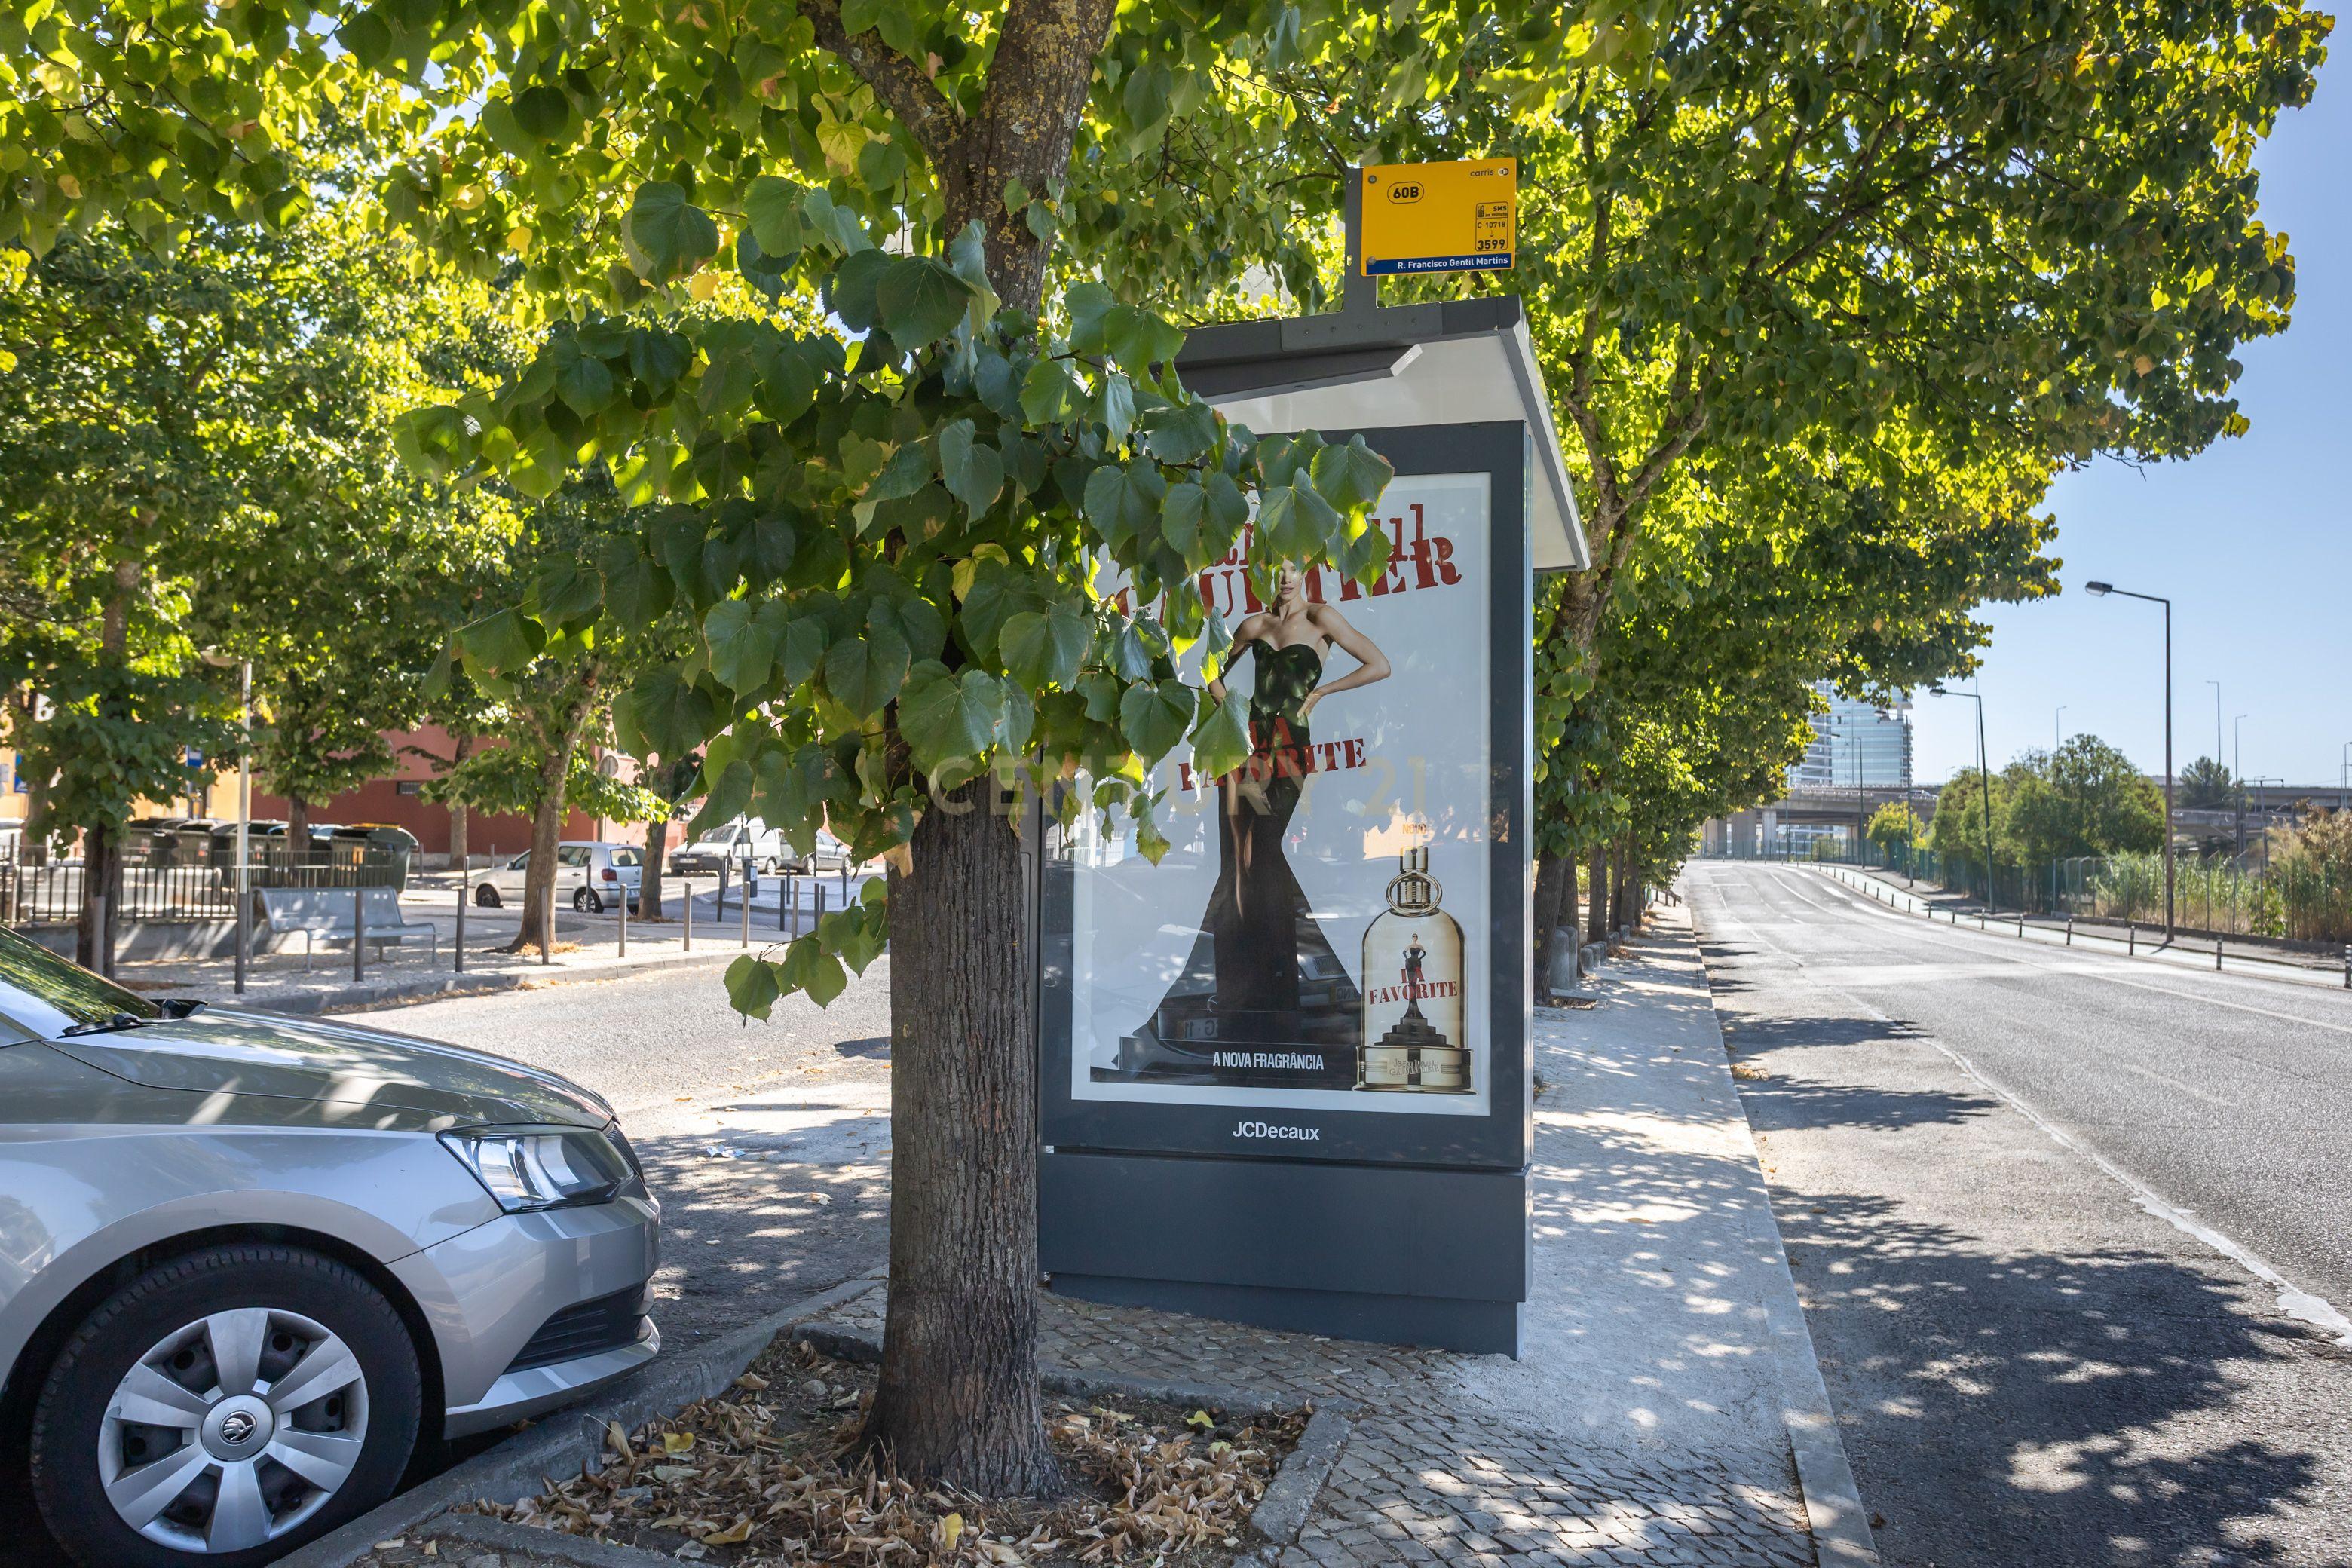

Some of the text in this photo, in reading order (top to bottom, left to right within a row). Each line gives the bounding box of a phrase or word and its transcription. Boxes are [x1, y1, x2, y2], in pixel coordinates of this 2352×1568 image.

[1470, 168, 1494, 177] carris
[1393, 186, 1419, 199] 60B
[1478, 239, 1505, 250] 3599
[1398, 256, 1508, 270] R. Francisco Gentil Martins
[1400, 966, 1425, 983] LA
[1369, 981, 1458, 1004] FAVORITE
[1213, 1052, 1325, 1070] A NOVA FRAGRÂNCIA
[1232, 1121, 1320, 1141] JCDecaux
